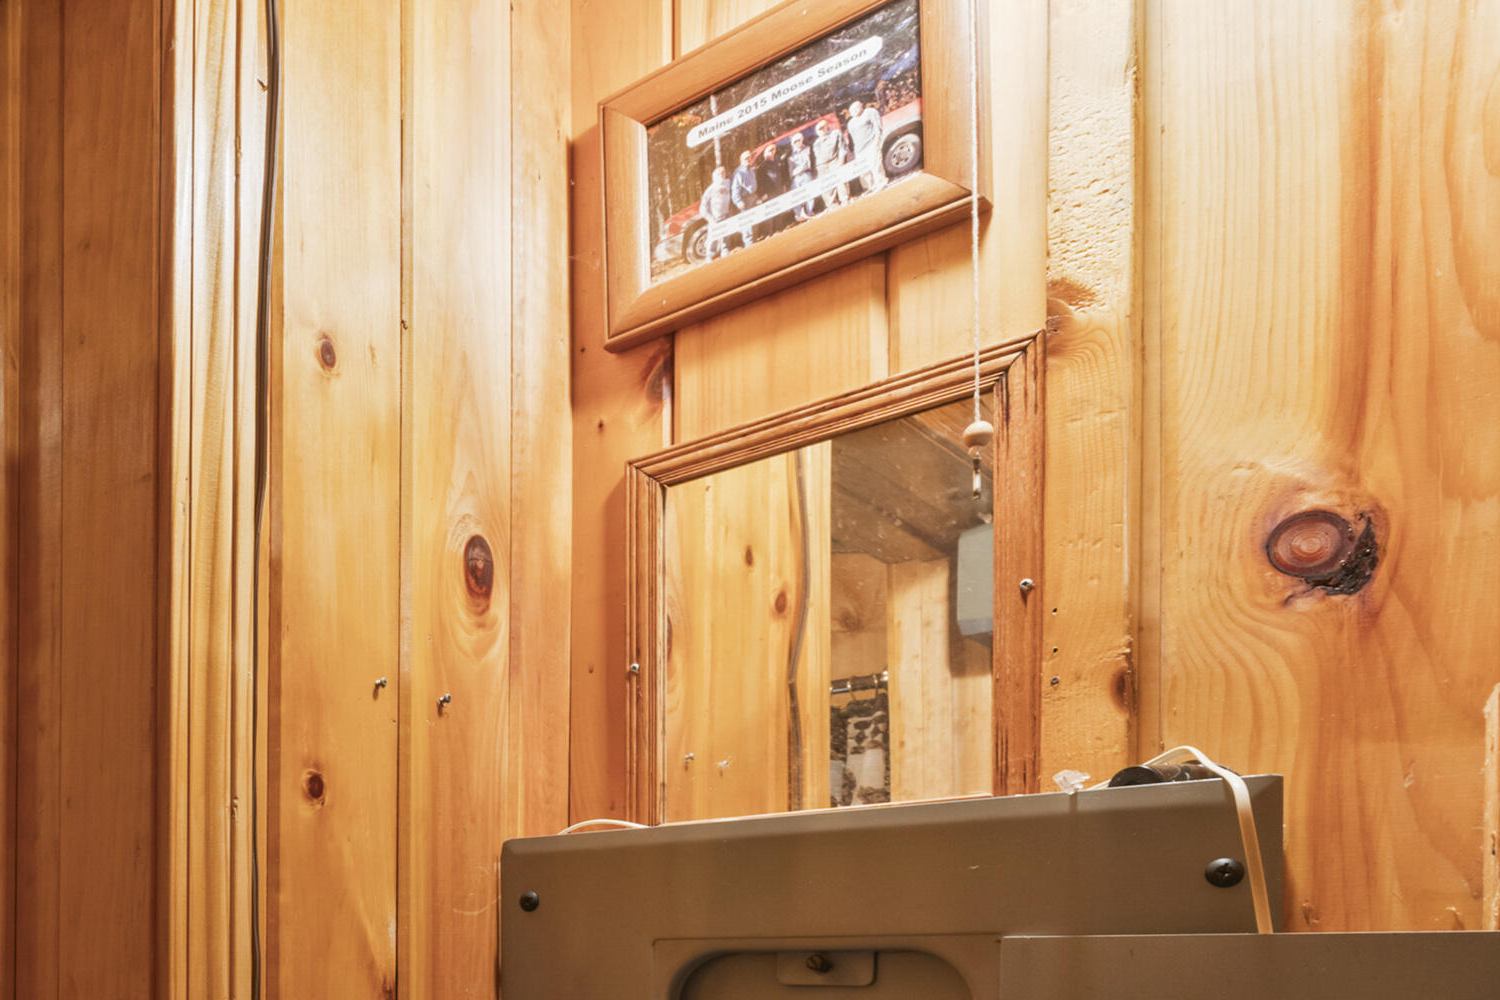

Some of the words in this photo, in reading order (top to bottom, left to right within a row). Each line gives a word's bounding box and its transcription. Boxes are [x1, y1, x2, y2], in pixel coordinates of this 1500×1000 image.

[697, 117, 734, 138] Maine
[737, 100, 767, 119] 2015
[771, 77, 814, 101] Moose
[818, 49, 867, 78] Season
